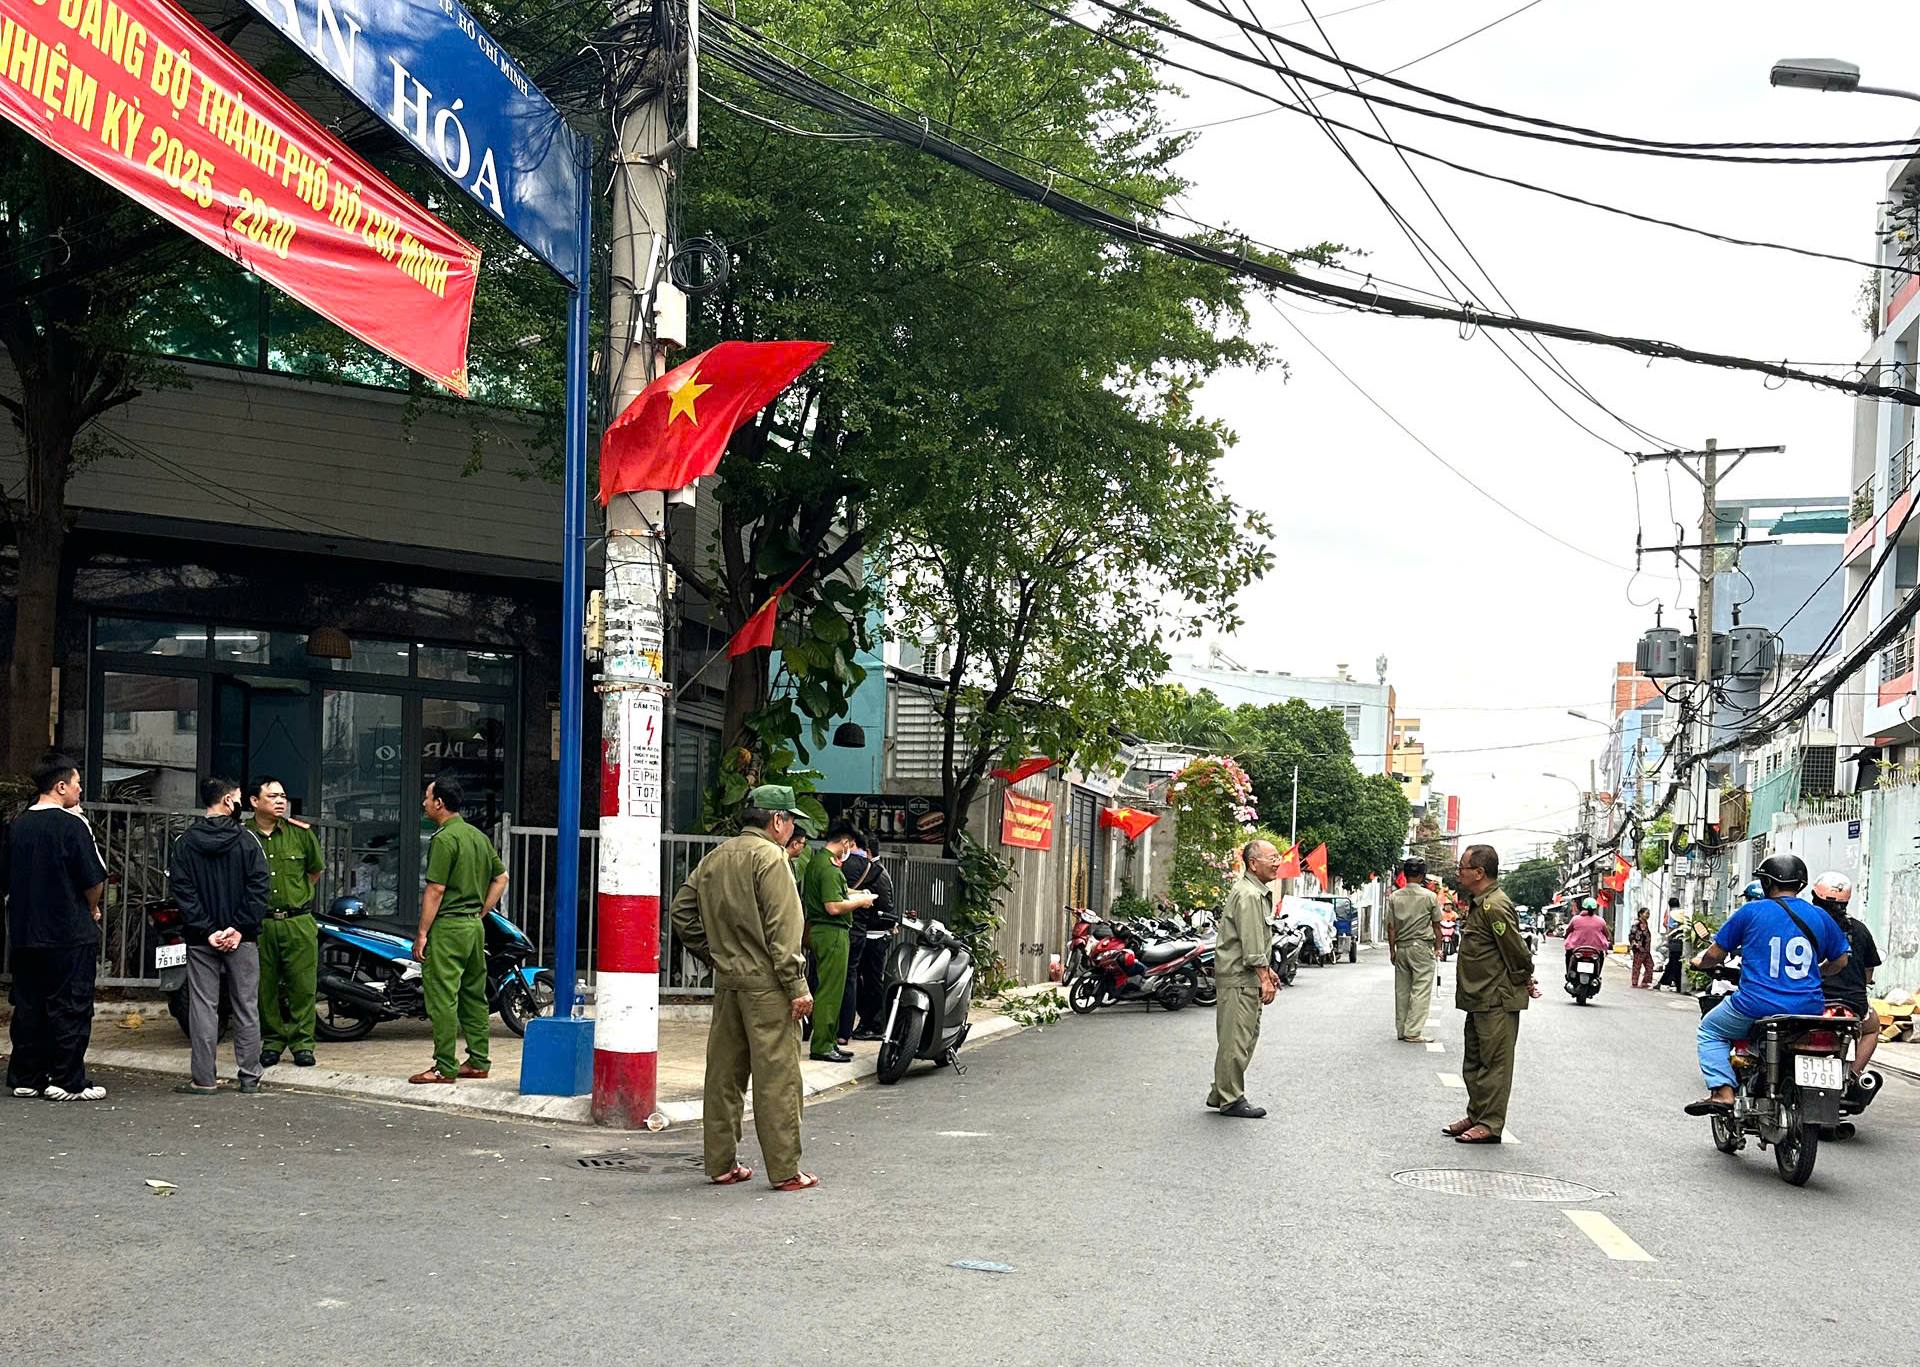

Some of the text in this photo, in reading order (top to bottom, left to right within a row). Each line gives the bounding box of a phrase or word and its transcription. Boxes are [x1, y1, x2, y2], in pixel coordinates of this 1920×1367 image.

[457, 11, 476, 40] HỒ
[478, 35, 498, 66] CHÍ
[500, 57, 528, 97] MINH
[101, 91, 145, 160] KỲ
[146, 126, 216, 208] 2025
[232, 188, 297, 260] 2030
[151, 40, 192, 121] BỘ
[197, 76, 281, 178] THÀNH
[282, 141, 332, 212] PHỐ
[328, 179, 363, 235] HỒ
[361, 207, 401, 262] CHÍ
[396, 231, 450, 299] MINH
[388, 55, 505, 219] HÓA
[1768, 936, 1813, 980] 19
[1802, 1071, 1836, 1086] 9796
